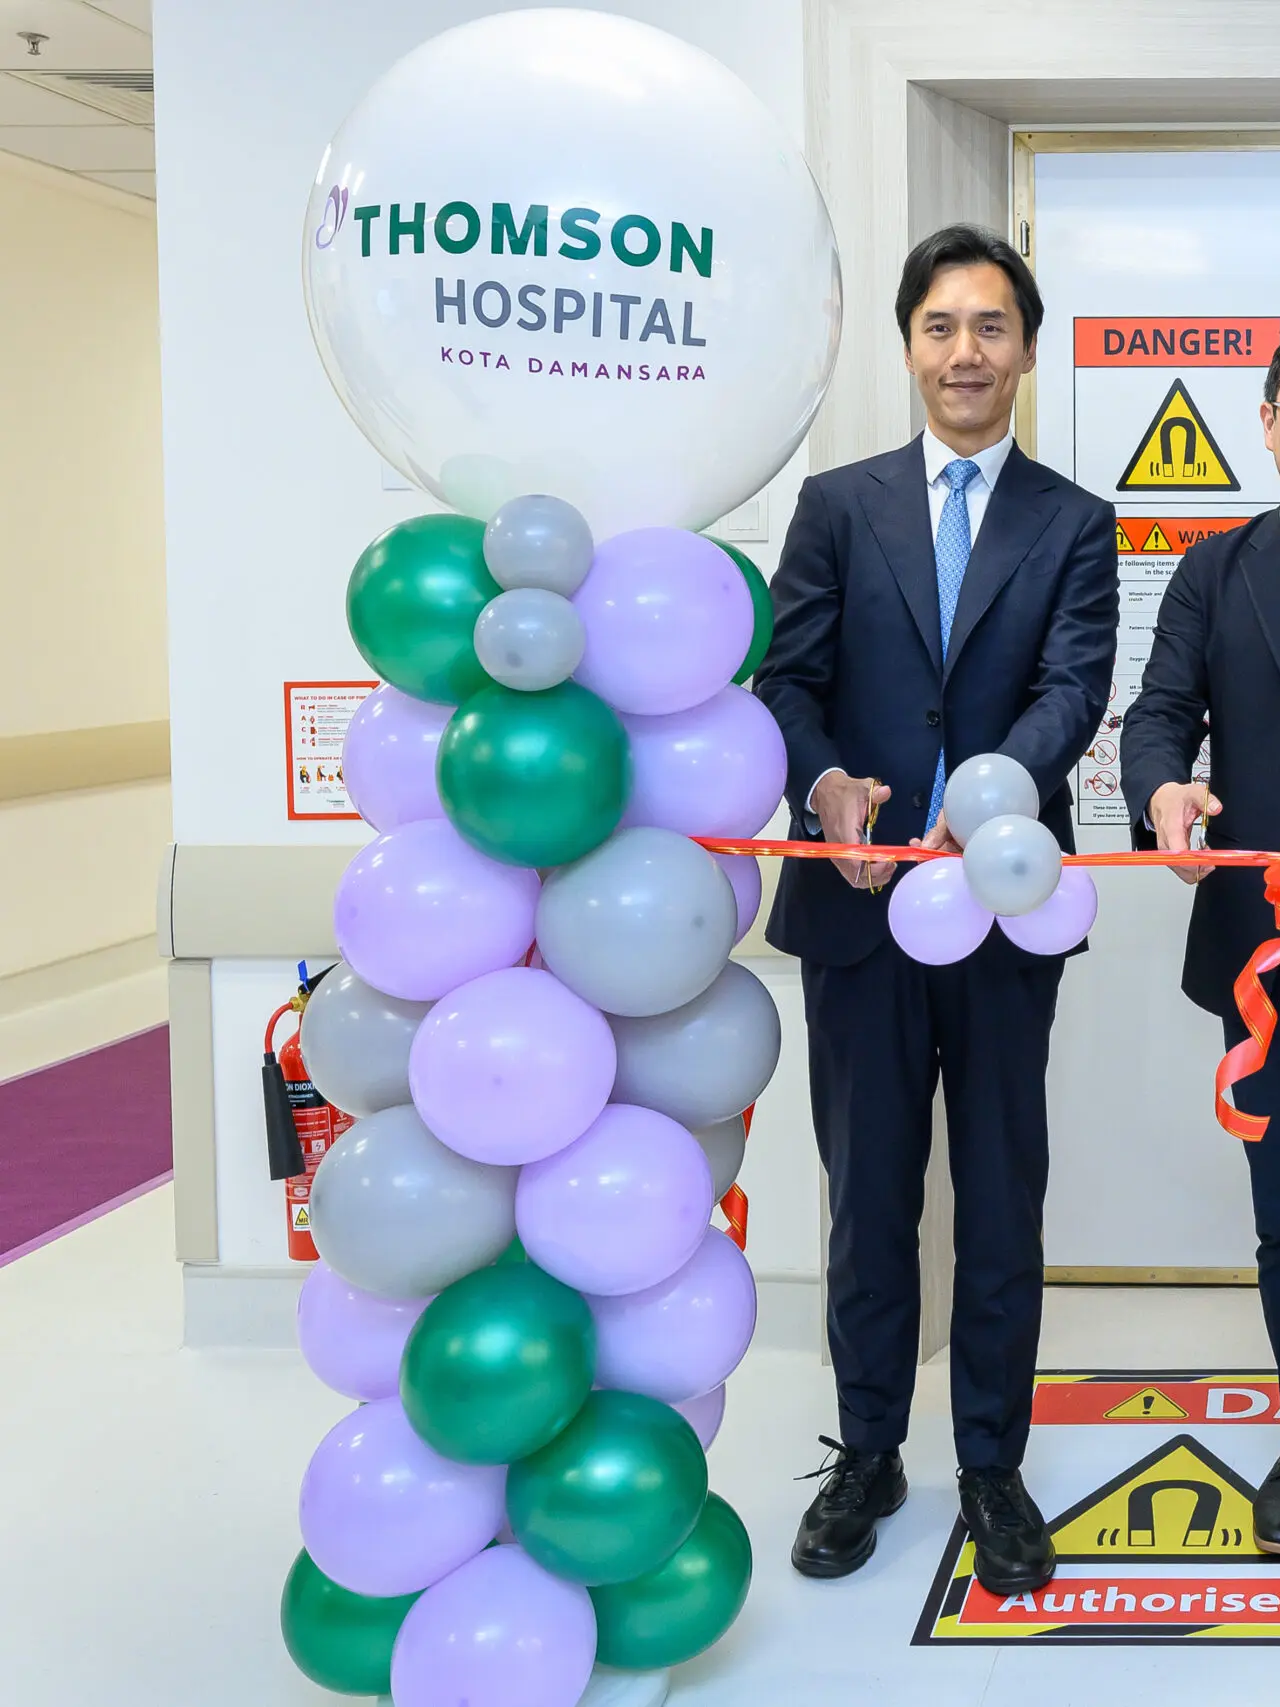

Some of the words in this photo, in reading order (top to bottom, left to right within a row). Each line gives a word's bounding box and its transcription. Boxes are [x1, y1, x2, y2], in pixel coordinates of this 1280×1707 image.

[353, 200, 714, 279] THOMSON
[435, 276, 707, 347] HOSPITAL
[1103, 328, 1253, 356] DANGER!
[440, 345, 512, 371] KOTA
[527, 356, 707, 382] DAMANSARA
[1124, 559, 1156, 568] following
